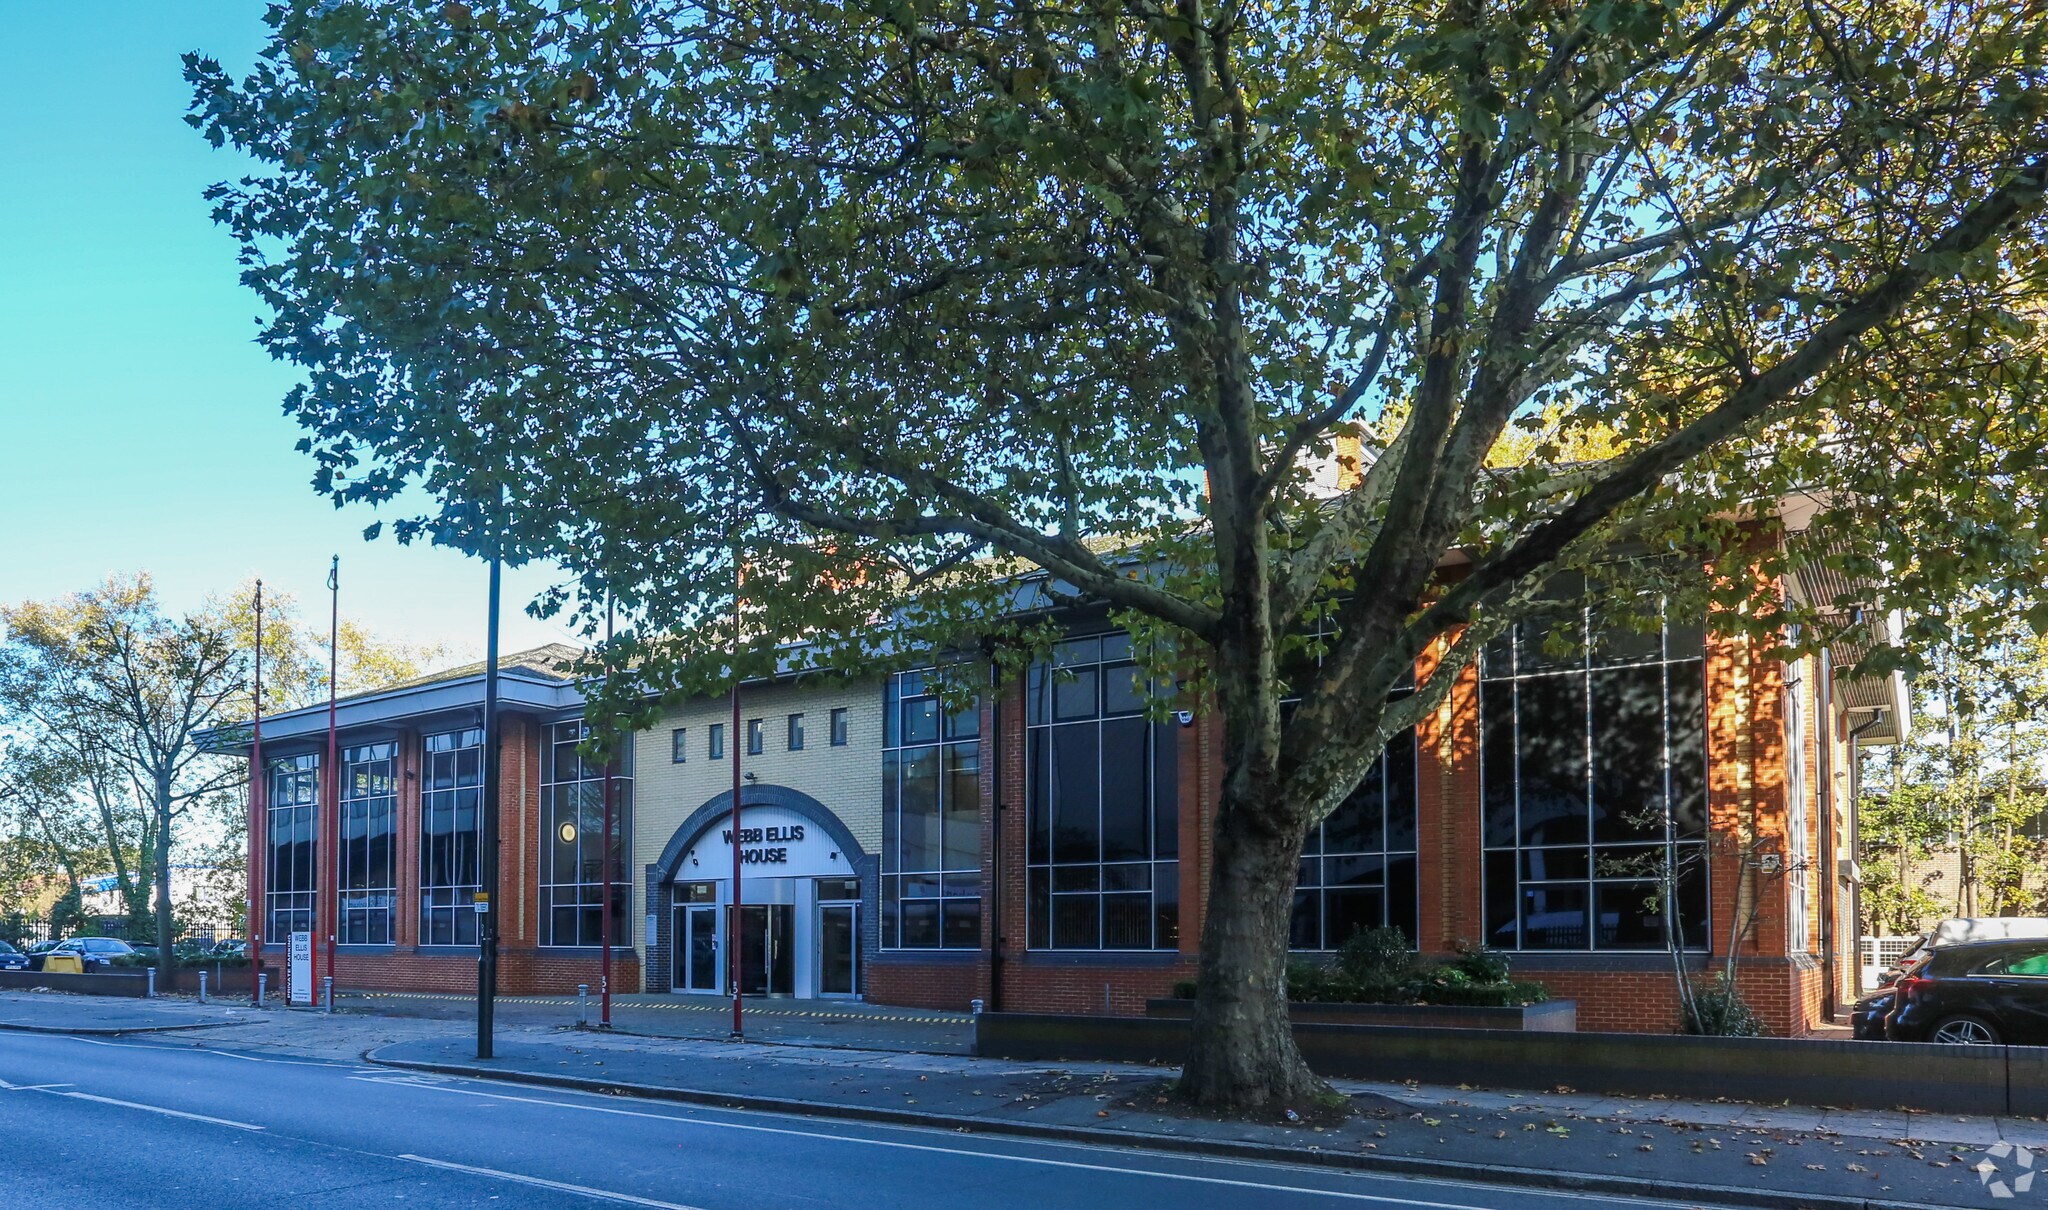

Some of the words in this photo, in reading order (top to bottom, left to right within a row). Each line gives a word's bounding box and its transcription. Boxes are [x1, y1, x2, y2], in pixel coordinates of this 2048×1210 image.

[722, 828, 763, 845] WEBB
[766, 825, 804, 841] ELLIS
[740, 847, 787, 864] HOUSE
[294, 934, 308, 942] WEBB
[295, 944, 308, 952] ELLIS
[293, 953, 309, 961] HOUSE
